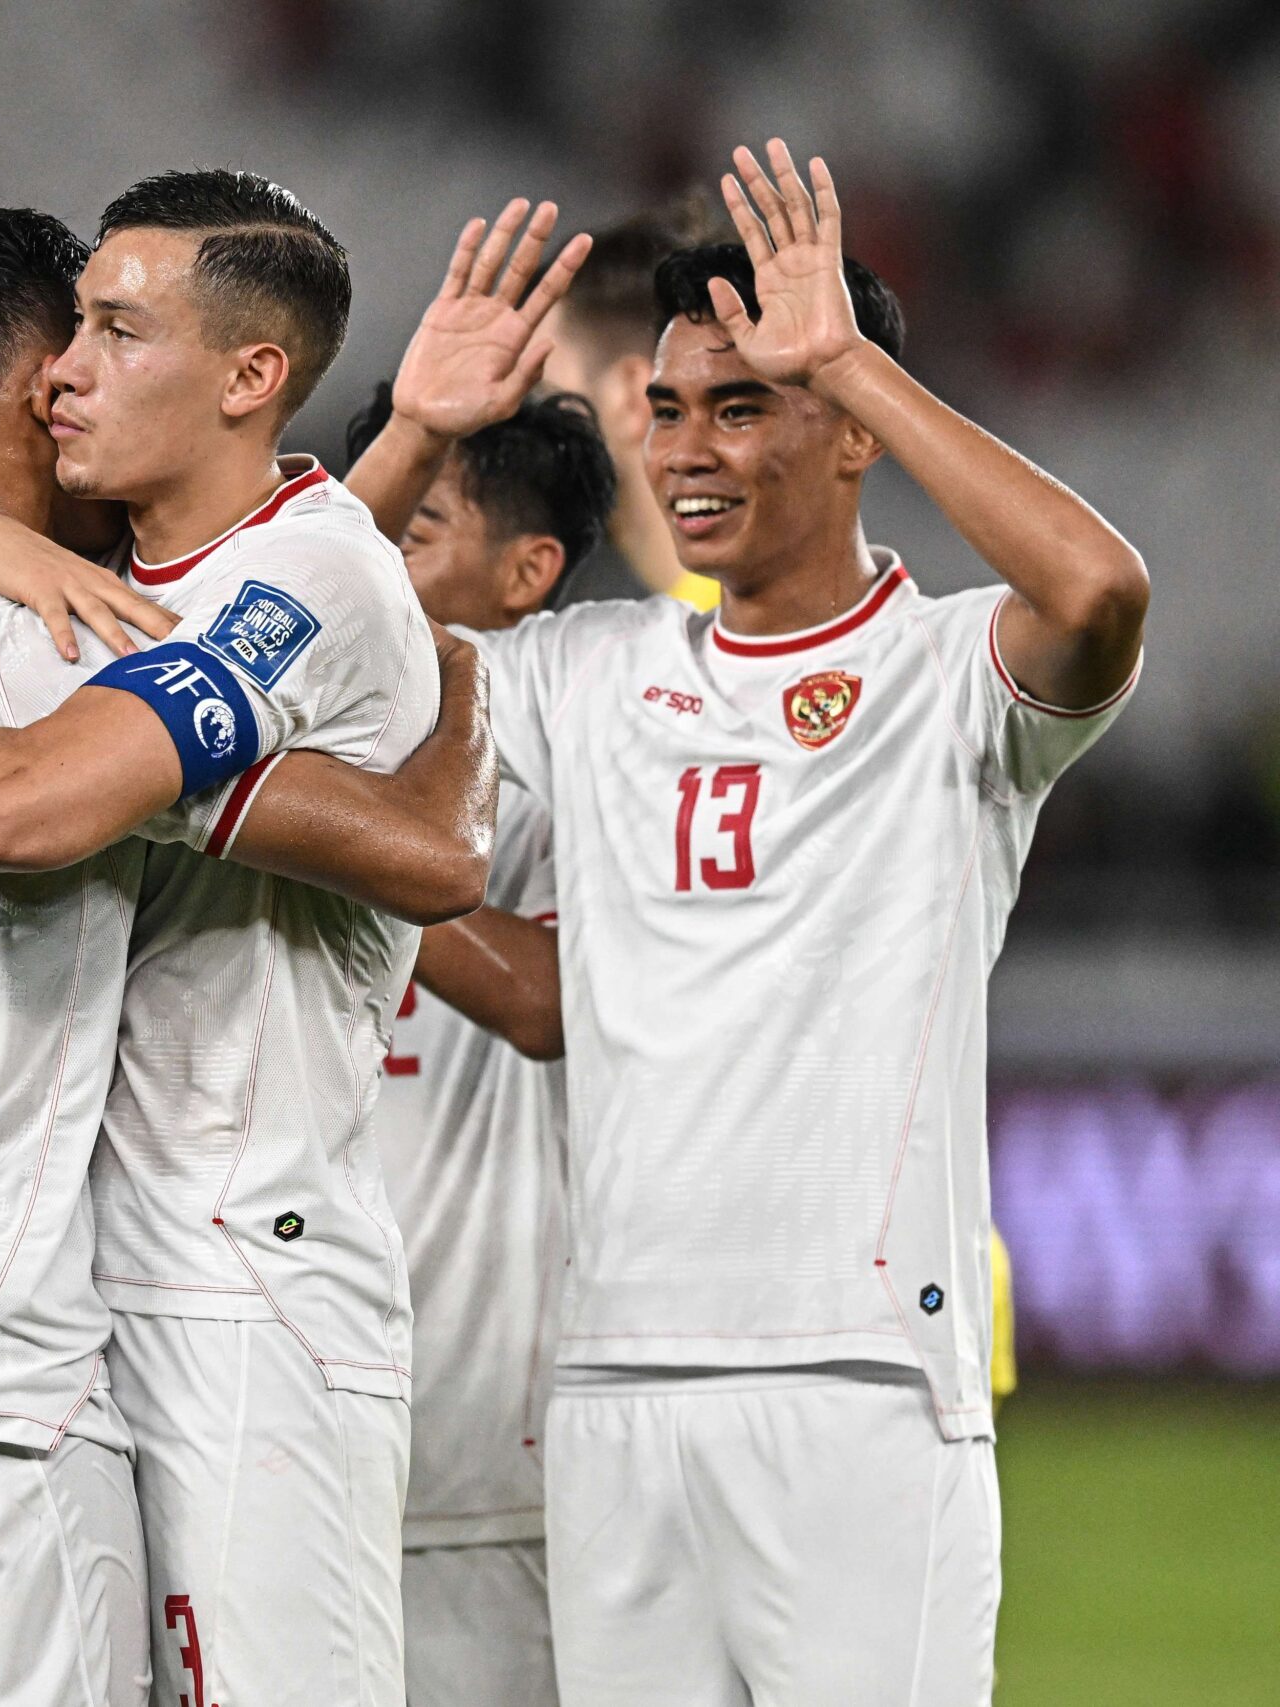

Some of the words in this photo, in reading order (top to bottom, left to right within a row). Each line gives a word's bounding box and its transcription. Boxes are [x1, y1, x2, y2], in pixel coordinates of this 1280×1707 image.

[242, 605, 290, 647] UNITES
[252, 598, 298, 634] FOOTBALL
[228, 619, 250, 640] the
[251, 632, 280, 662] World
[235, 639, 253, 659] FIFA
[643, 685, 704, 715] erspo
[675, 764, 761, 891] 13
[164, 1594, 205, 1707] 3
